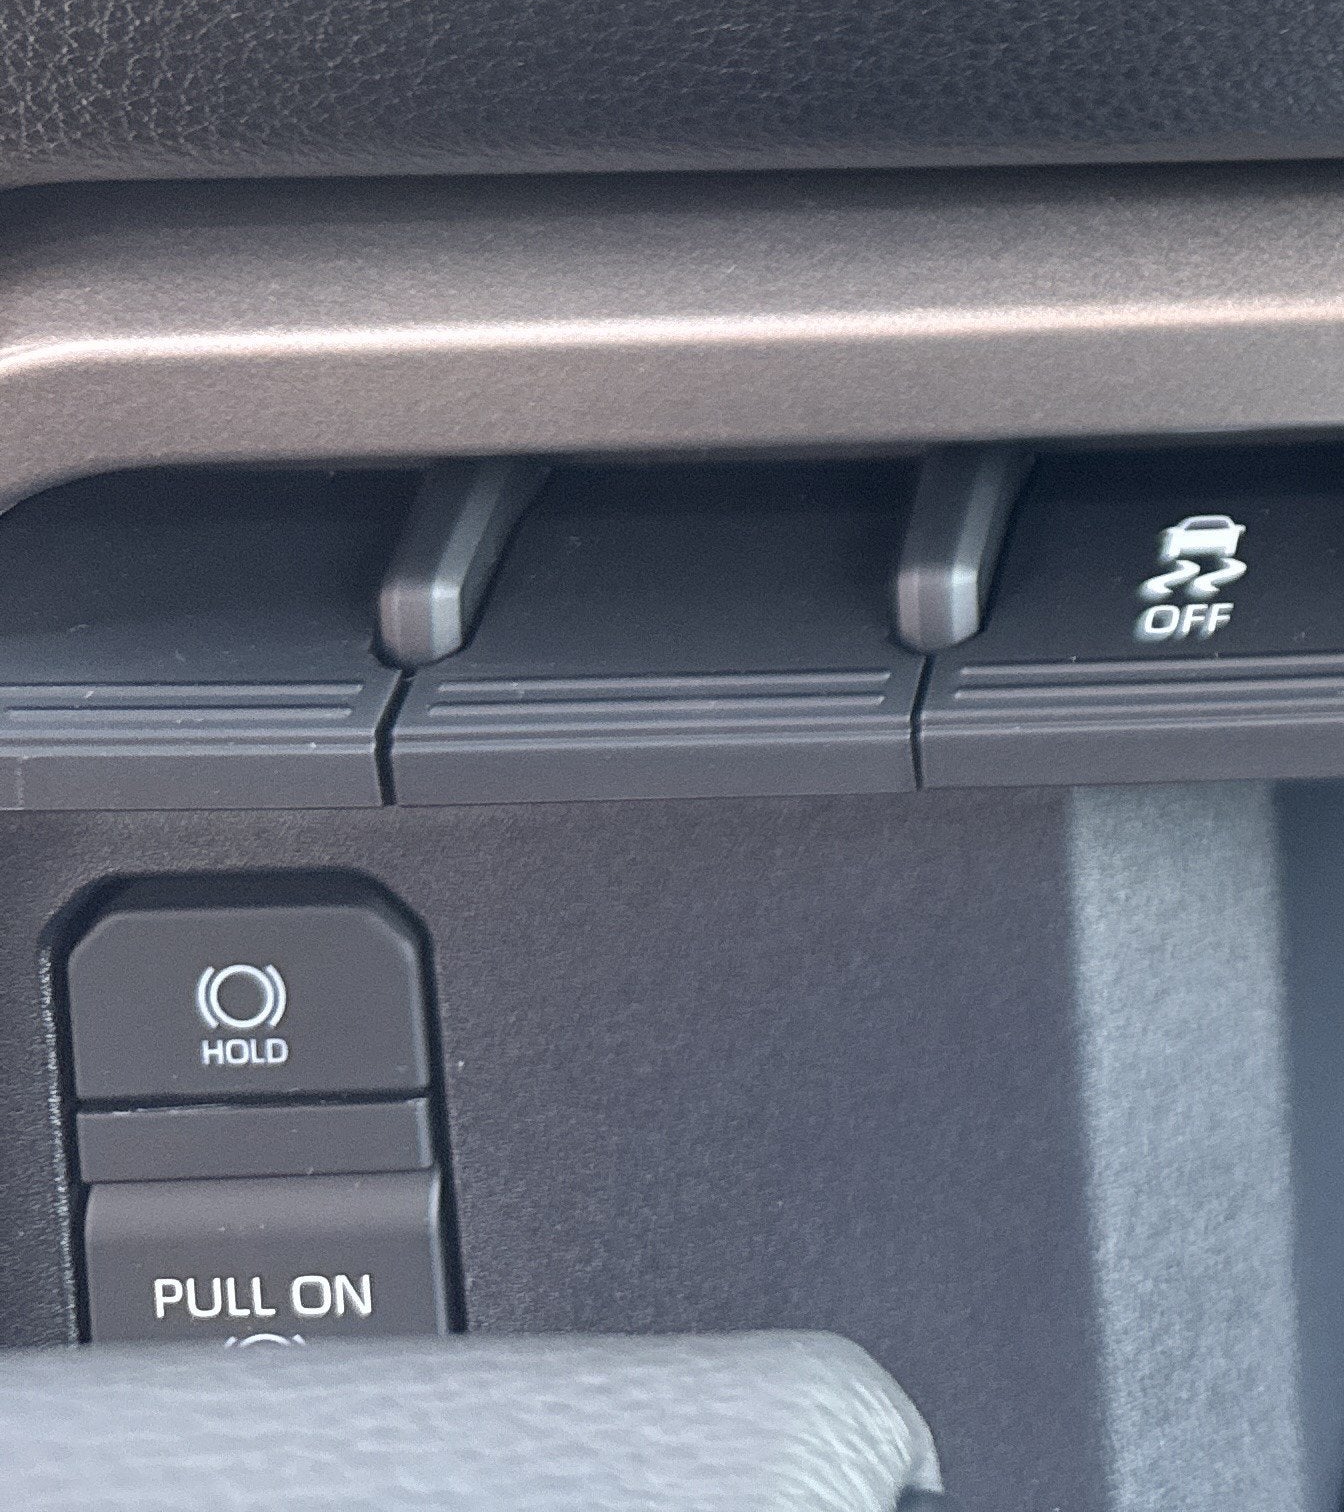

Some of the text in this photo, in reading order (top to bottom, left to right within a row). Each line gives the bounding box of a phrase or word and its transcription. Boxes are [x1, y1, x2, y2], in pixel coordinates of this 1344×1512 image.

[1136, 601, 1236, 640] OFF
[200, 1038, 290, 1066] HOLD
[153, 1274, 373, 1319] PULL ON
